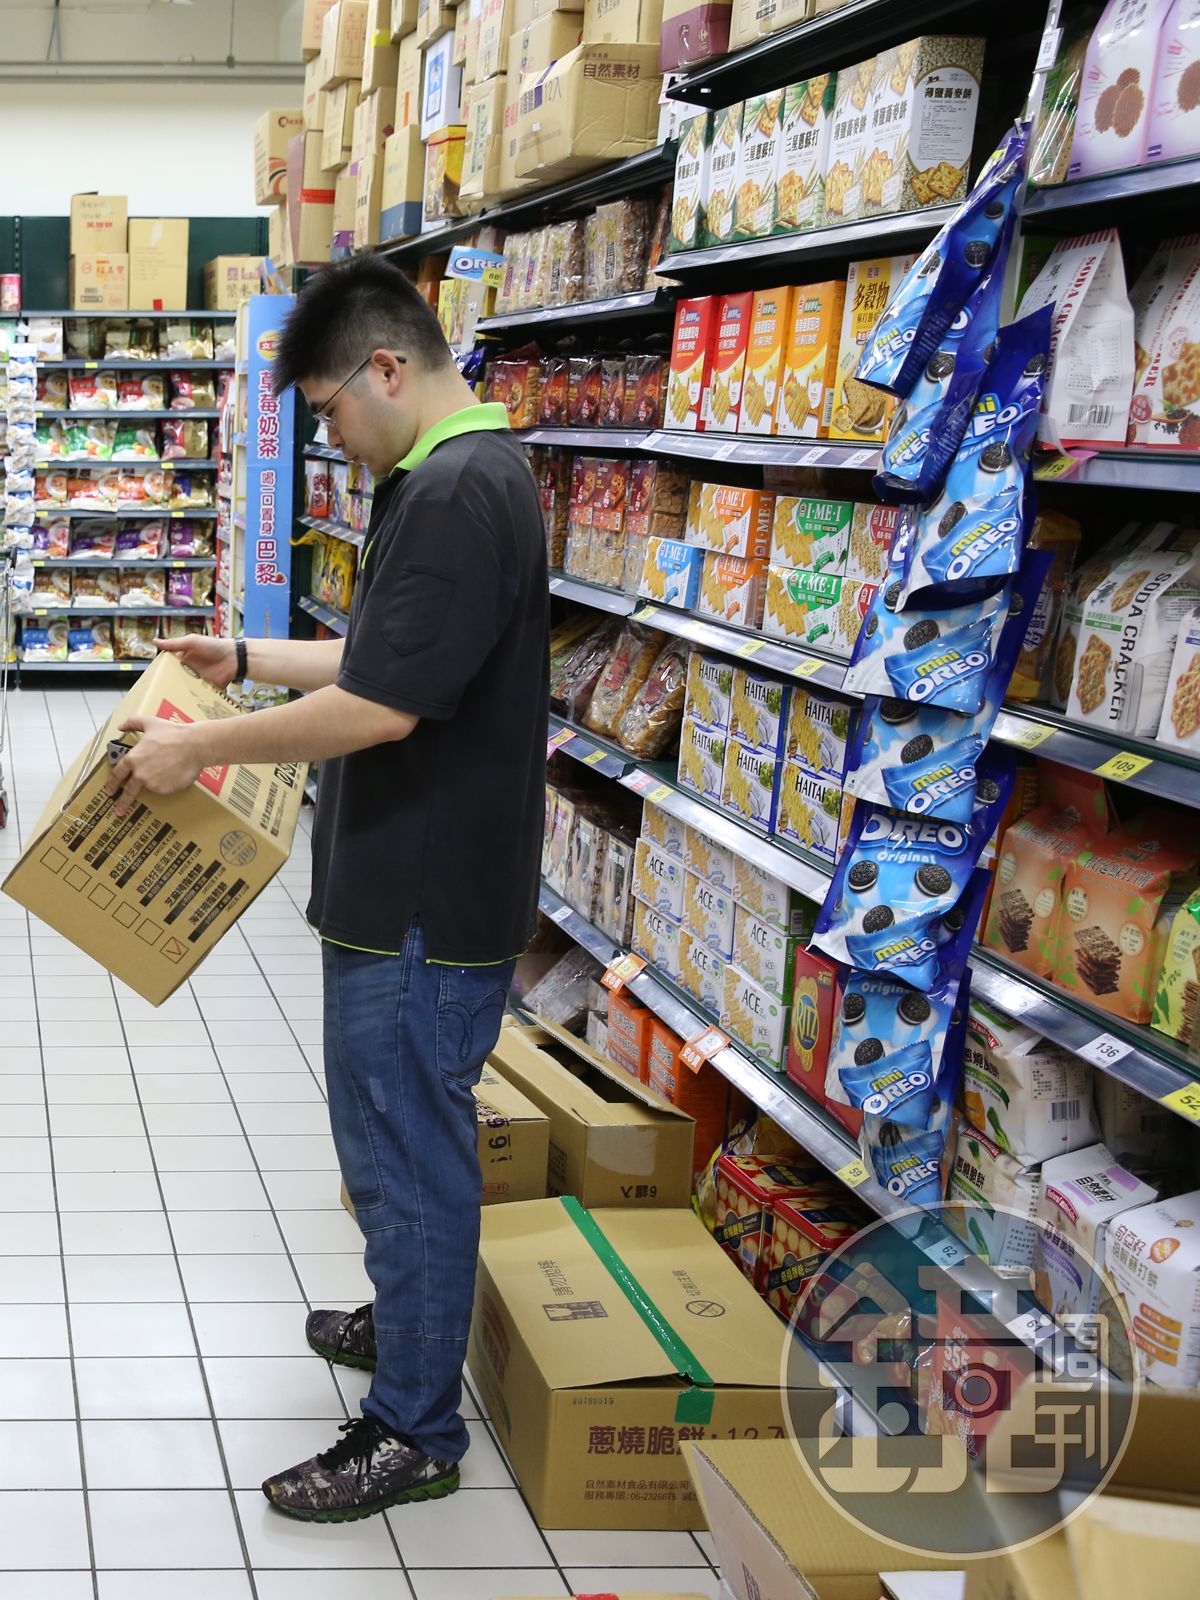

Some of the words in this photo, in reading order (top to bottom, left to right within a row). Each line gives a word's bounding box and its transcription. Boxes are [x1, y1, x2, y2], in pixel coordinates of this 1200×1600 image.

[583, 63, 641, 79] 自然素材
[946, 517, 1020, 581] OREO
[949, 521, 991, 556] mini
[1128, 571, 1172, 619] SODA
[917, 649, 961, 678] mini
[1108, 624, 1139, 721] CRACKER
[907, 651, 990, 704] OREO
[913, 763, 954, 792] mini
[1113, 758, 1134, 772] 109
[906, 767, 977, 816] OREO
[859, 817, 965, 849] OREO
[648, 855, 665, 877] ACE
[876, 850, 937, 865] Original
[698, 887, 713, 911] ACE
[646, 912, 662, 935] ACE
[750, 923, 768, 948] ACE
[691, 949, 707, 971] ACE
[874, 935, 916, 962] mini
[742, 989, 761, 1015] ACE
[1095, 1041, 1120, 1058] 136
[861, 1071, 926, 1114] OREO
[871, 1068, 904, 1093] mini
[890, 1153, 921, 1175] mini
[887, 1158, 939, 1198] OREO
[942, 1244, 959, 1261] 62
